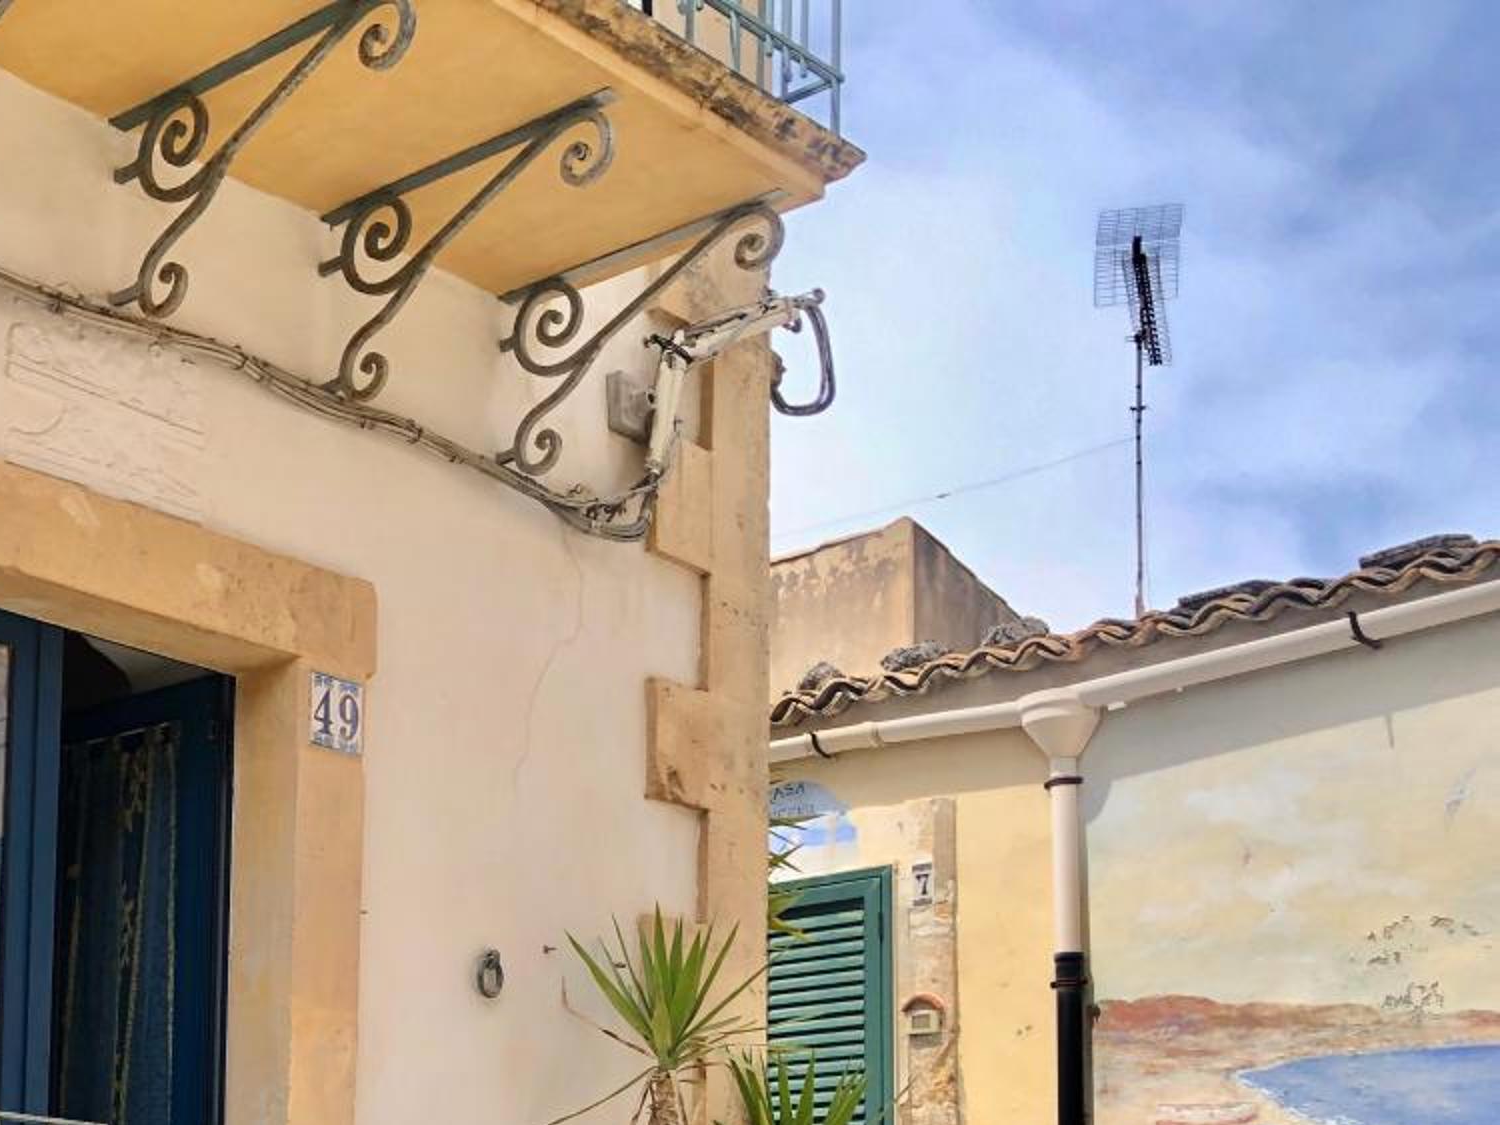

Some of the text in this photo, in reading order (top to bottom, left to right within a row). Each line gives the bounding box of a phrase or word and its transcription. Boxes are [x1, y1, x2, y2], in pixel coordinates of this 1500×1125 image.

[314, 689, 359, 741] 49
[770, 783, 805, 802] ASA
[915, 873, 929, 896] 7
